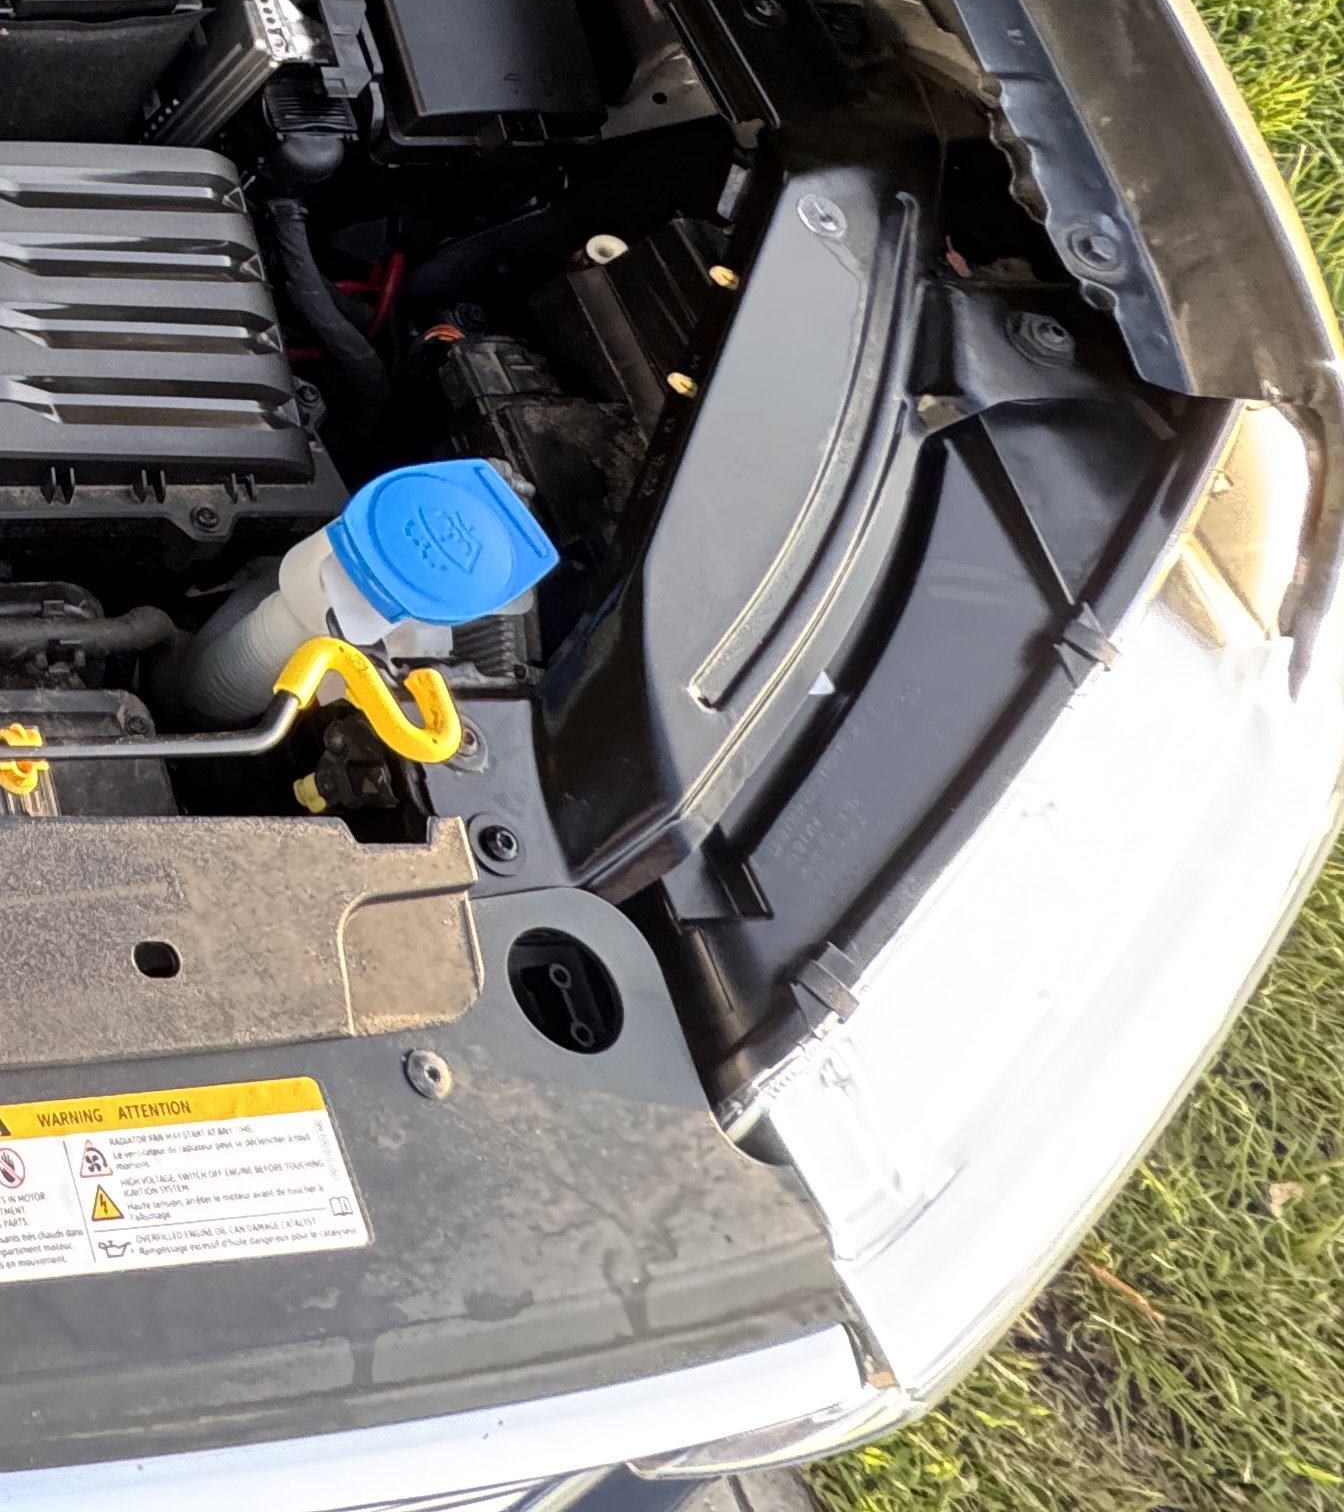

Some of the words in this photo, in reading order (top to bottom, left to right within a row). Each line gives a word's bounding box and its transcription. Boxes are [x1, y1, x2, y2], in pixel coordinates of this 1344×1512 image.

[37, 1108, 104, 1128] WARNING
[118, 1100, 192, 1120] ATTENTION
[109, 1134, 147, 1146] RADIATOR
[148, 1132, 164, 1143] FAN
[182, 1128, 205, 1140] START
[207, 1127, 217, 1137] AT
[113, 1151, 123, 1161] Le
[120, 1176, 140, 1188] HIGH
[178, 1171, 208, 1182] SWITCH
[224, 1166, 253, 1178] ENGINE
[255, 1163, 284, 1175] BEFORE
[284, 1159, 324, 1172] TOUCHING
[7, 1194, 16, 1204] IN
[17, 1191, 46, 1203] MOTOR
[123, 1185, 159, 1198] IGNITION
